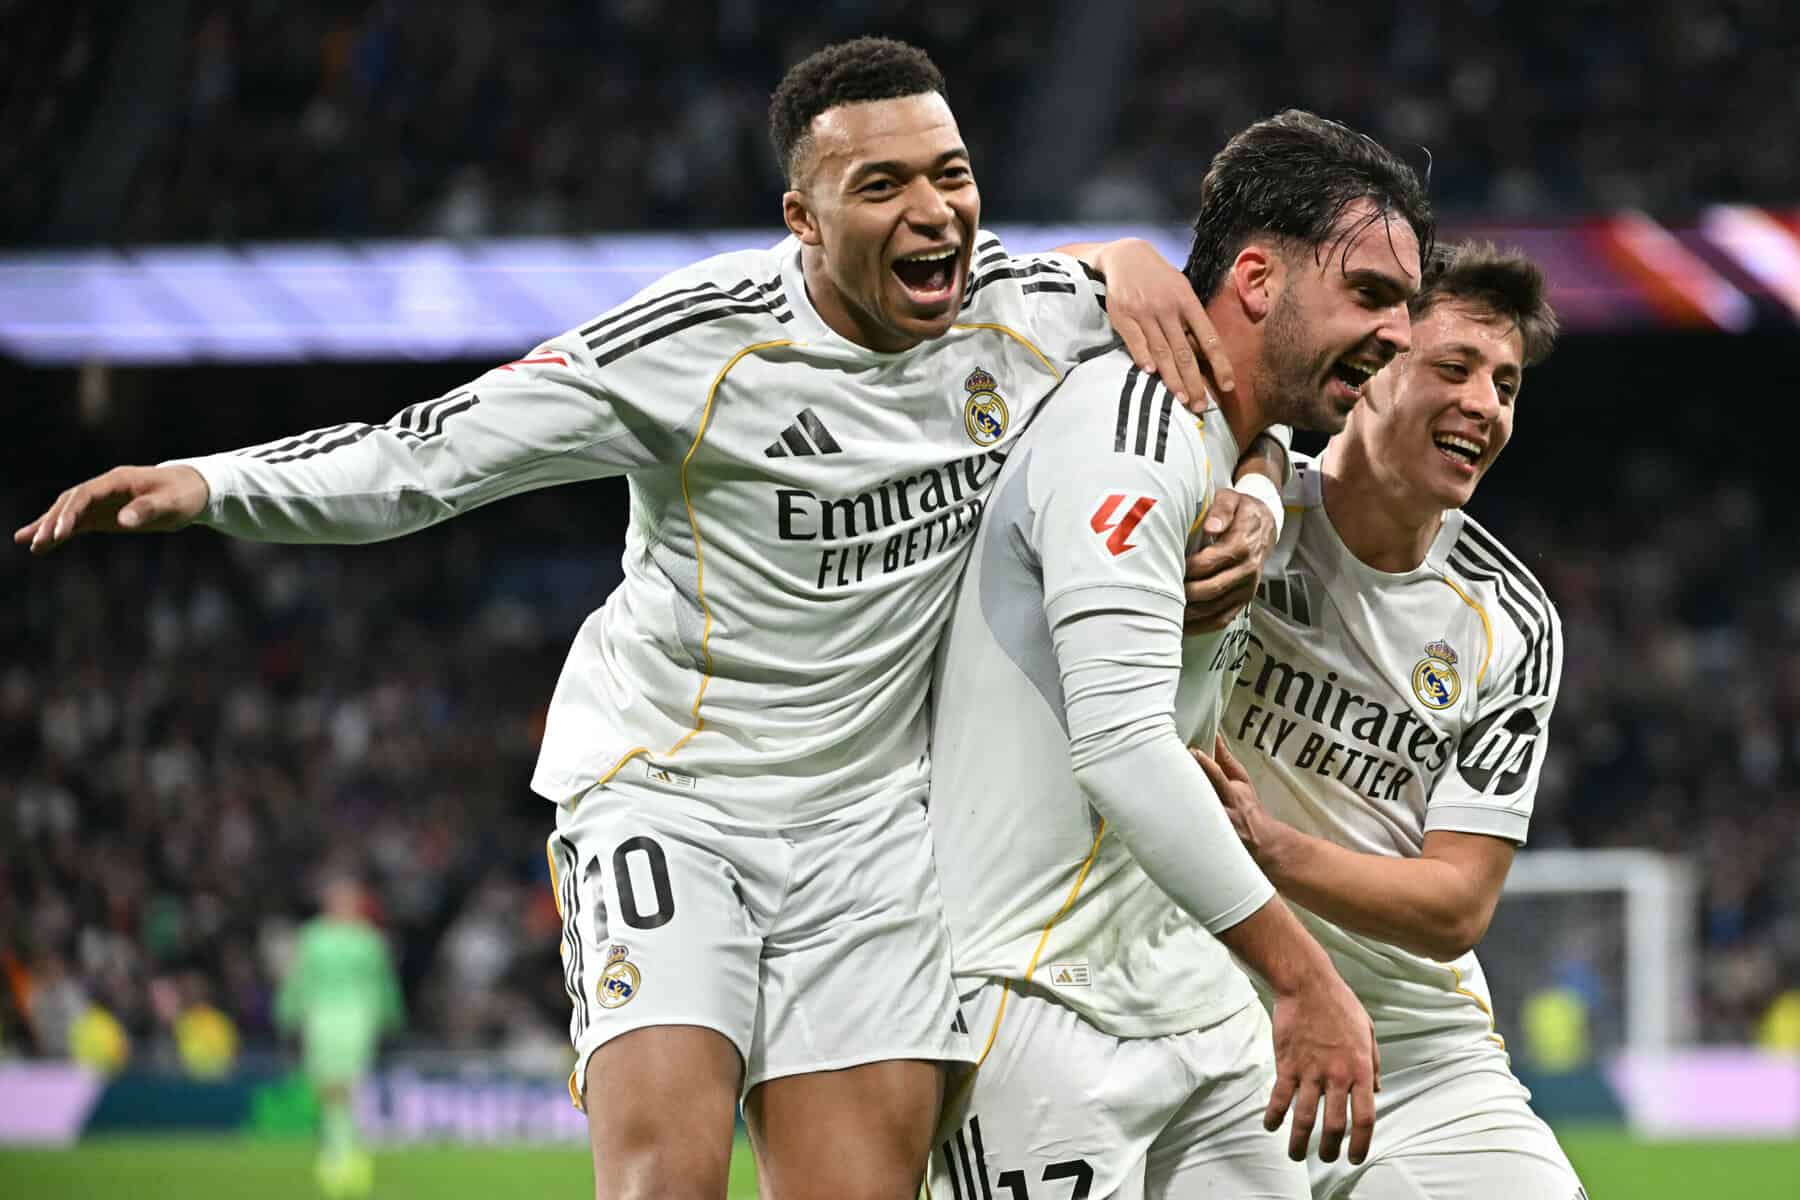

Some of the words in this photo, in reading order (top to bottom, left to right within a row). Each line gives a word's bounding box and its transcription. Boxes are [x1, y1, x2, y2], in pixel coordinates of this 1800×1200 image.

[817, 542, 874, 589] FLY
[1237, 704, 1297, 758] FLY
[1295, 732, 1414, 801] BETTER
[583, 836, 675, 945] 10
